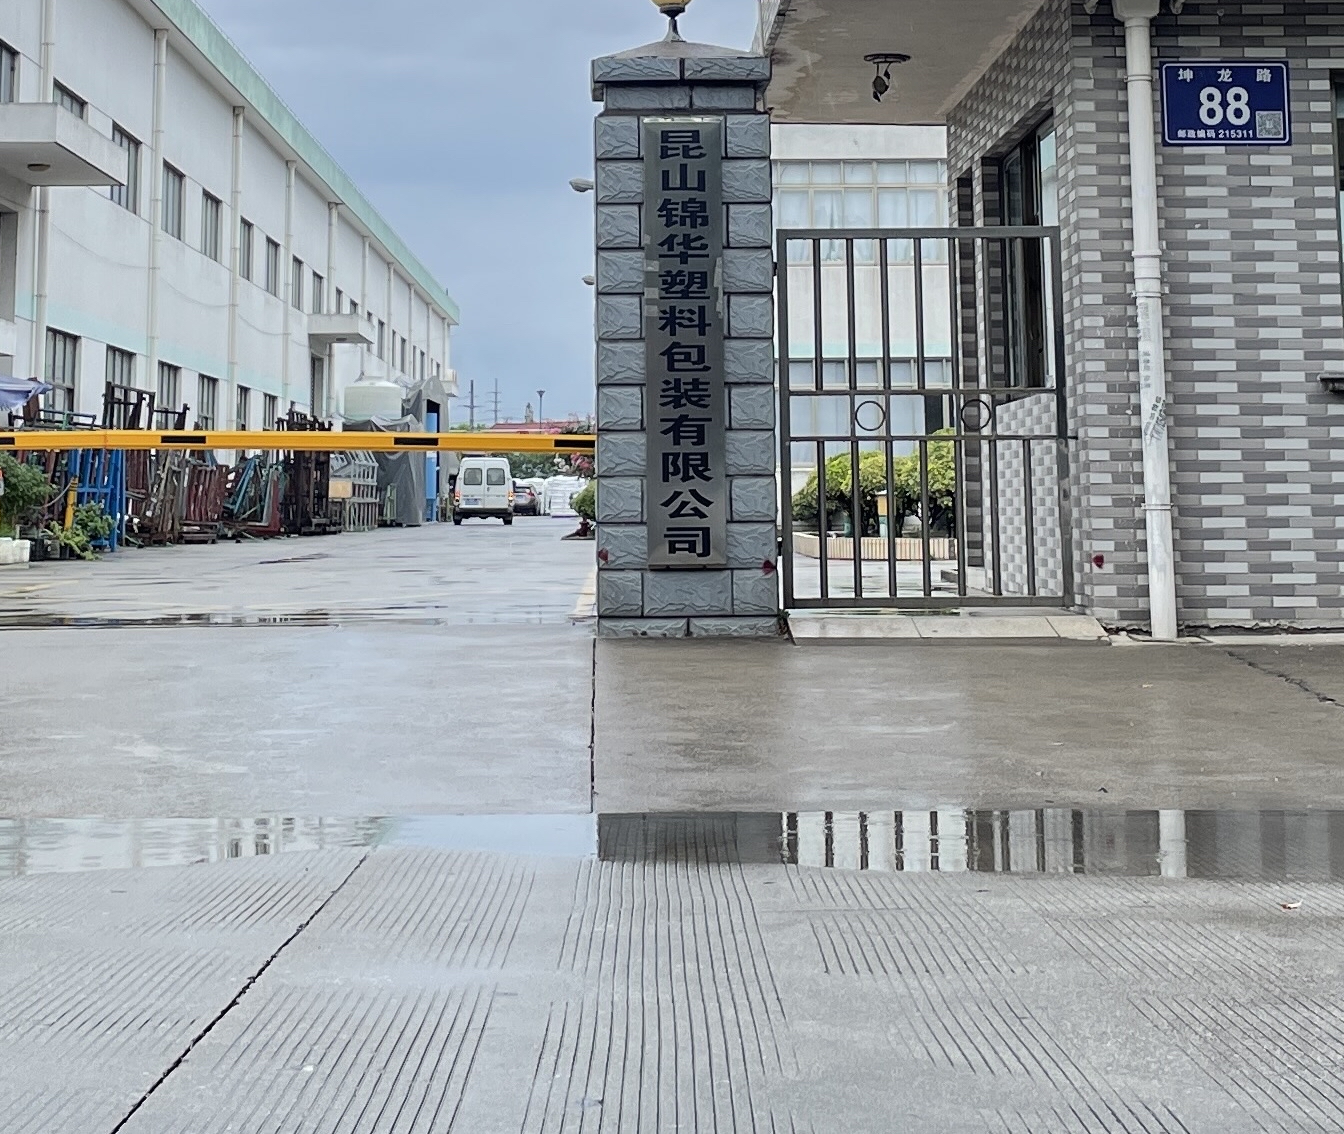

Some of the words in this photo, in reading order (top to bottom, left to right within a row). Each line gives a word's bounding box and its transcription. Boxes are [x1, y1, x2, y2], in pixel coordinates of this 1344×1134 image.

[1177, 68, 1272, 83] 坤龙路
[1199, 86, 1251, 126] 88
[1218, 129, 1253, 139] 215311
[657, 129, 715, 558] 昆山锦华塑料包装有限公司
